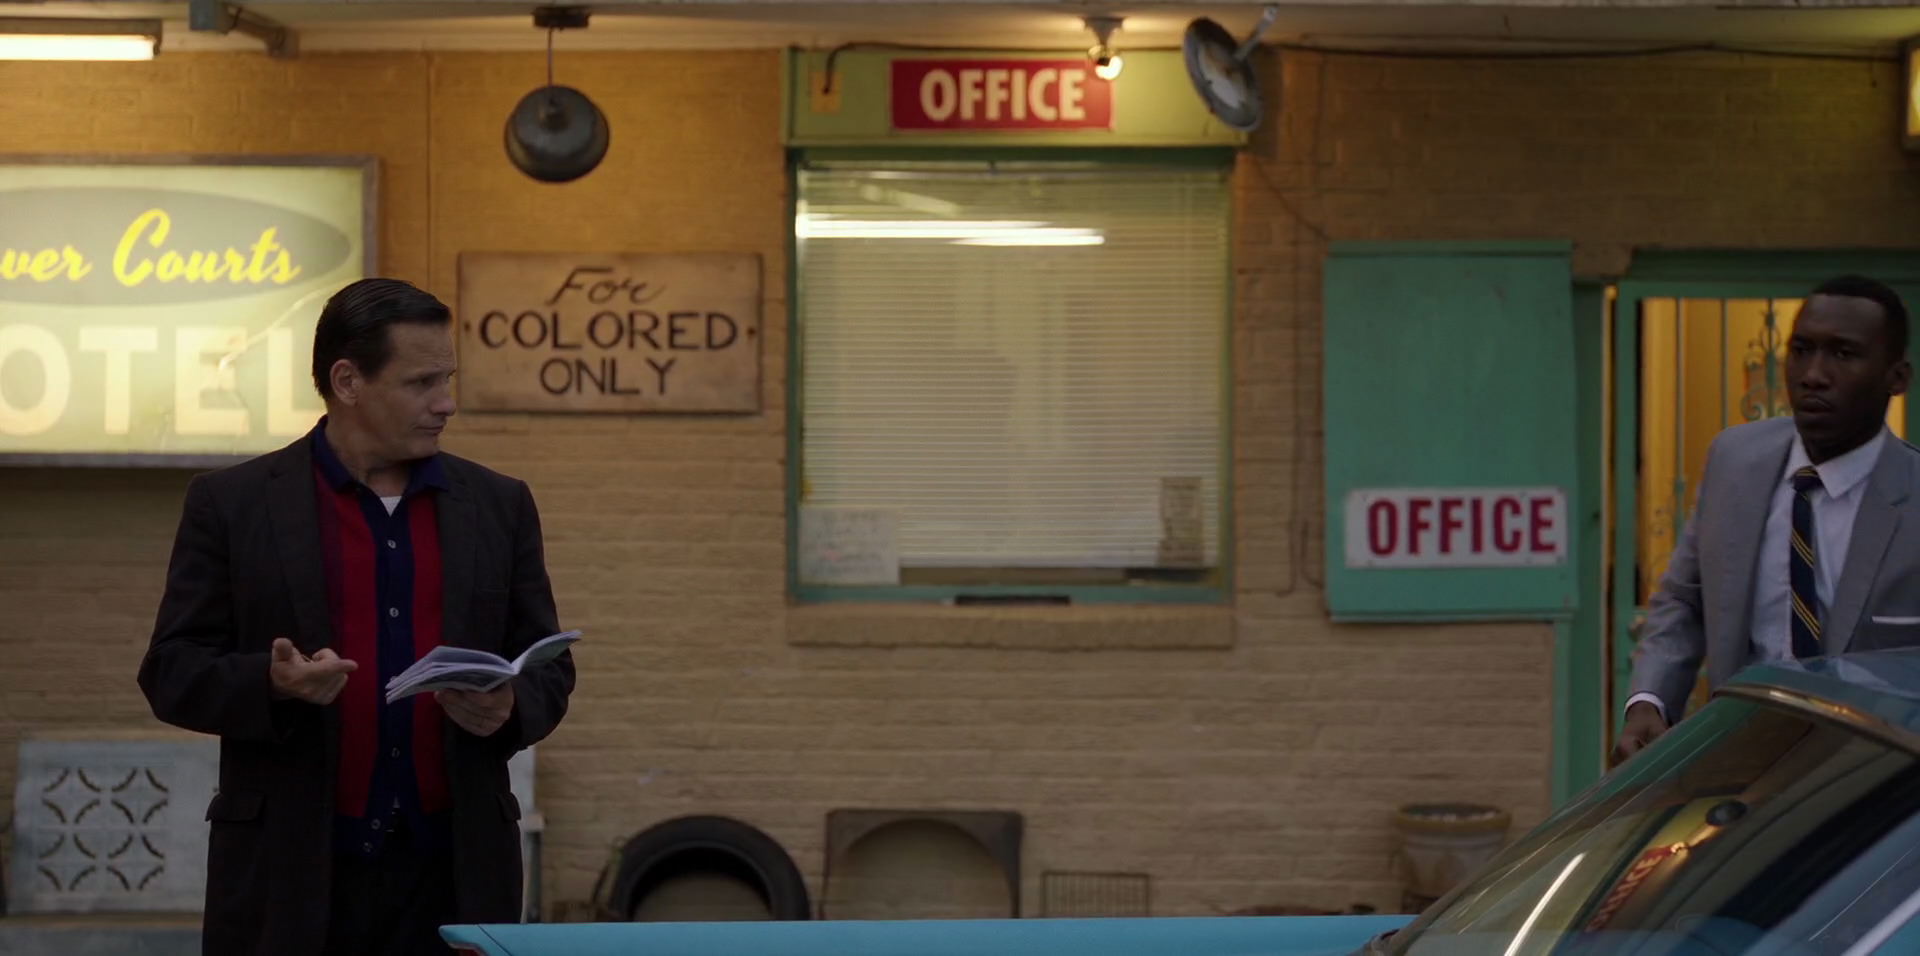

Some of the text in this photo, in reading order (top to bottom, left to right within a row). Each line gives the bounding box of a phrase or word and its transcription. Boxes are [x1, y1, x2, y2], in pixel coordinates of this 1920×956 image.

[920, 69, 1086, 121] OFFICE
[113, 208, 301, 287] Courts
[547, 266, 664, 305] For
[480, 311, 738, 351] COLORED
[0, 324, 328, 436] OTEL
[541, 358, 677, 395] ONLY
[1367, 498, 1557, 556] OFFICE
